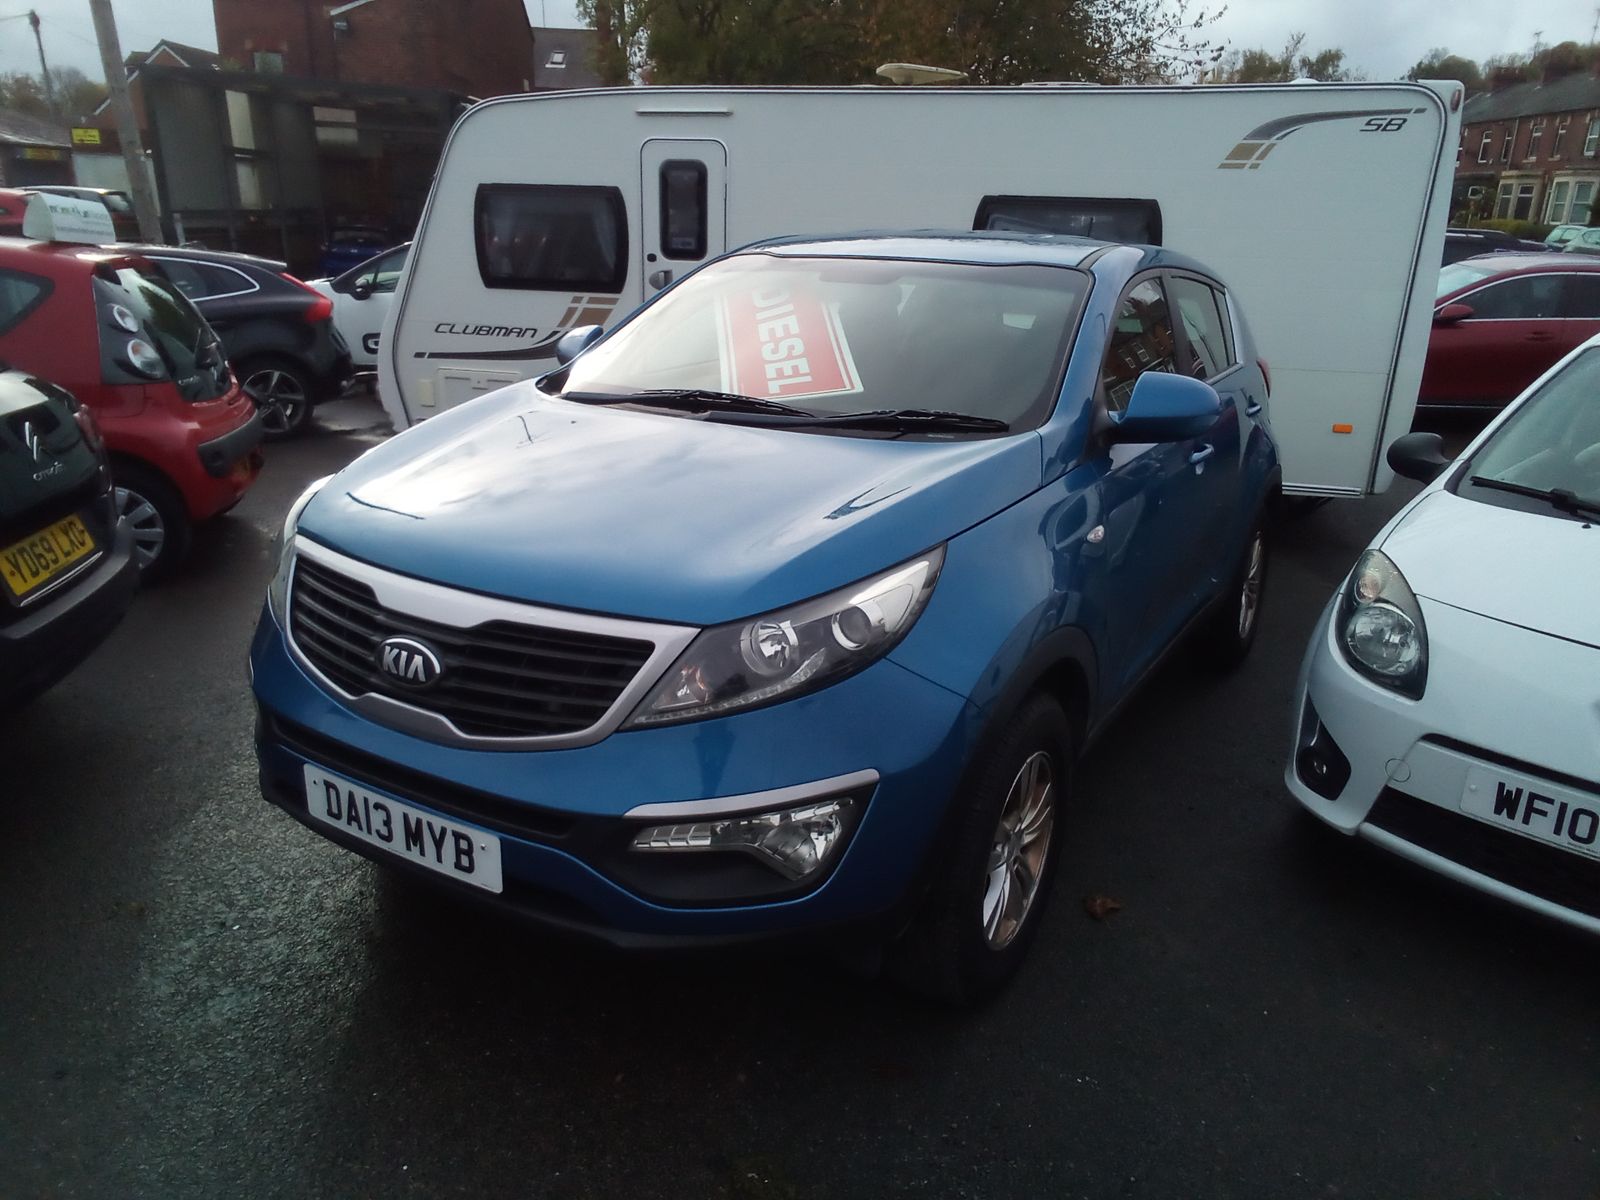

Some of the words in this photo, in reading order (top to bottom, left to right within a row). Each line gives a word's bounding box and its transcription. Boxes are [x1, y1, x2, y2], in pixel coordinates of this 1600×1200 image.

[1359, 117, 1408, 132] SB
[434, 322, 538, 339] CLUBMAN
[751, 283, 812, 395] DIESEL
[382, 645, 426, 682] KIA
[322, 778, 394, 843] DA13
[403, 811, 475, 875] MYB
[1493, 781, 1600, 845] WF10
